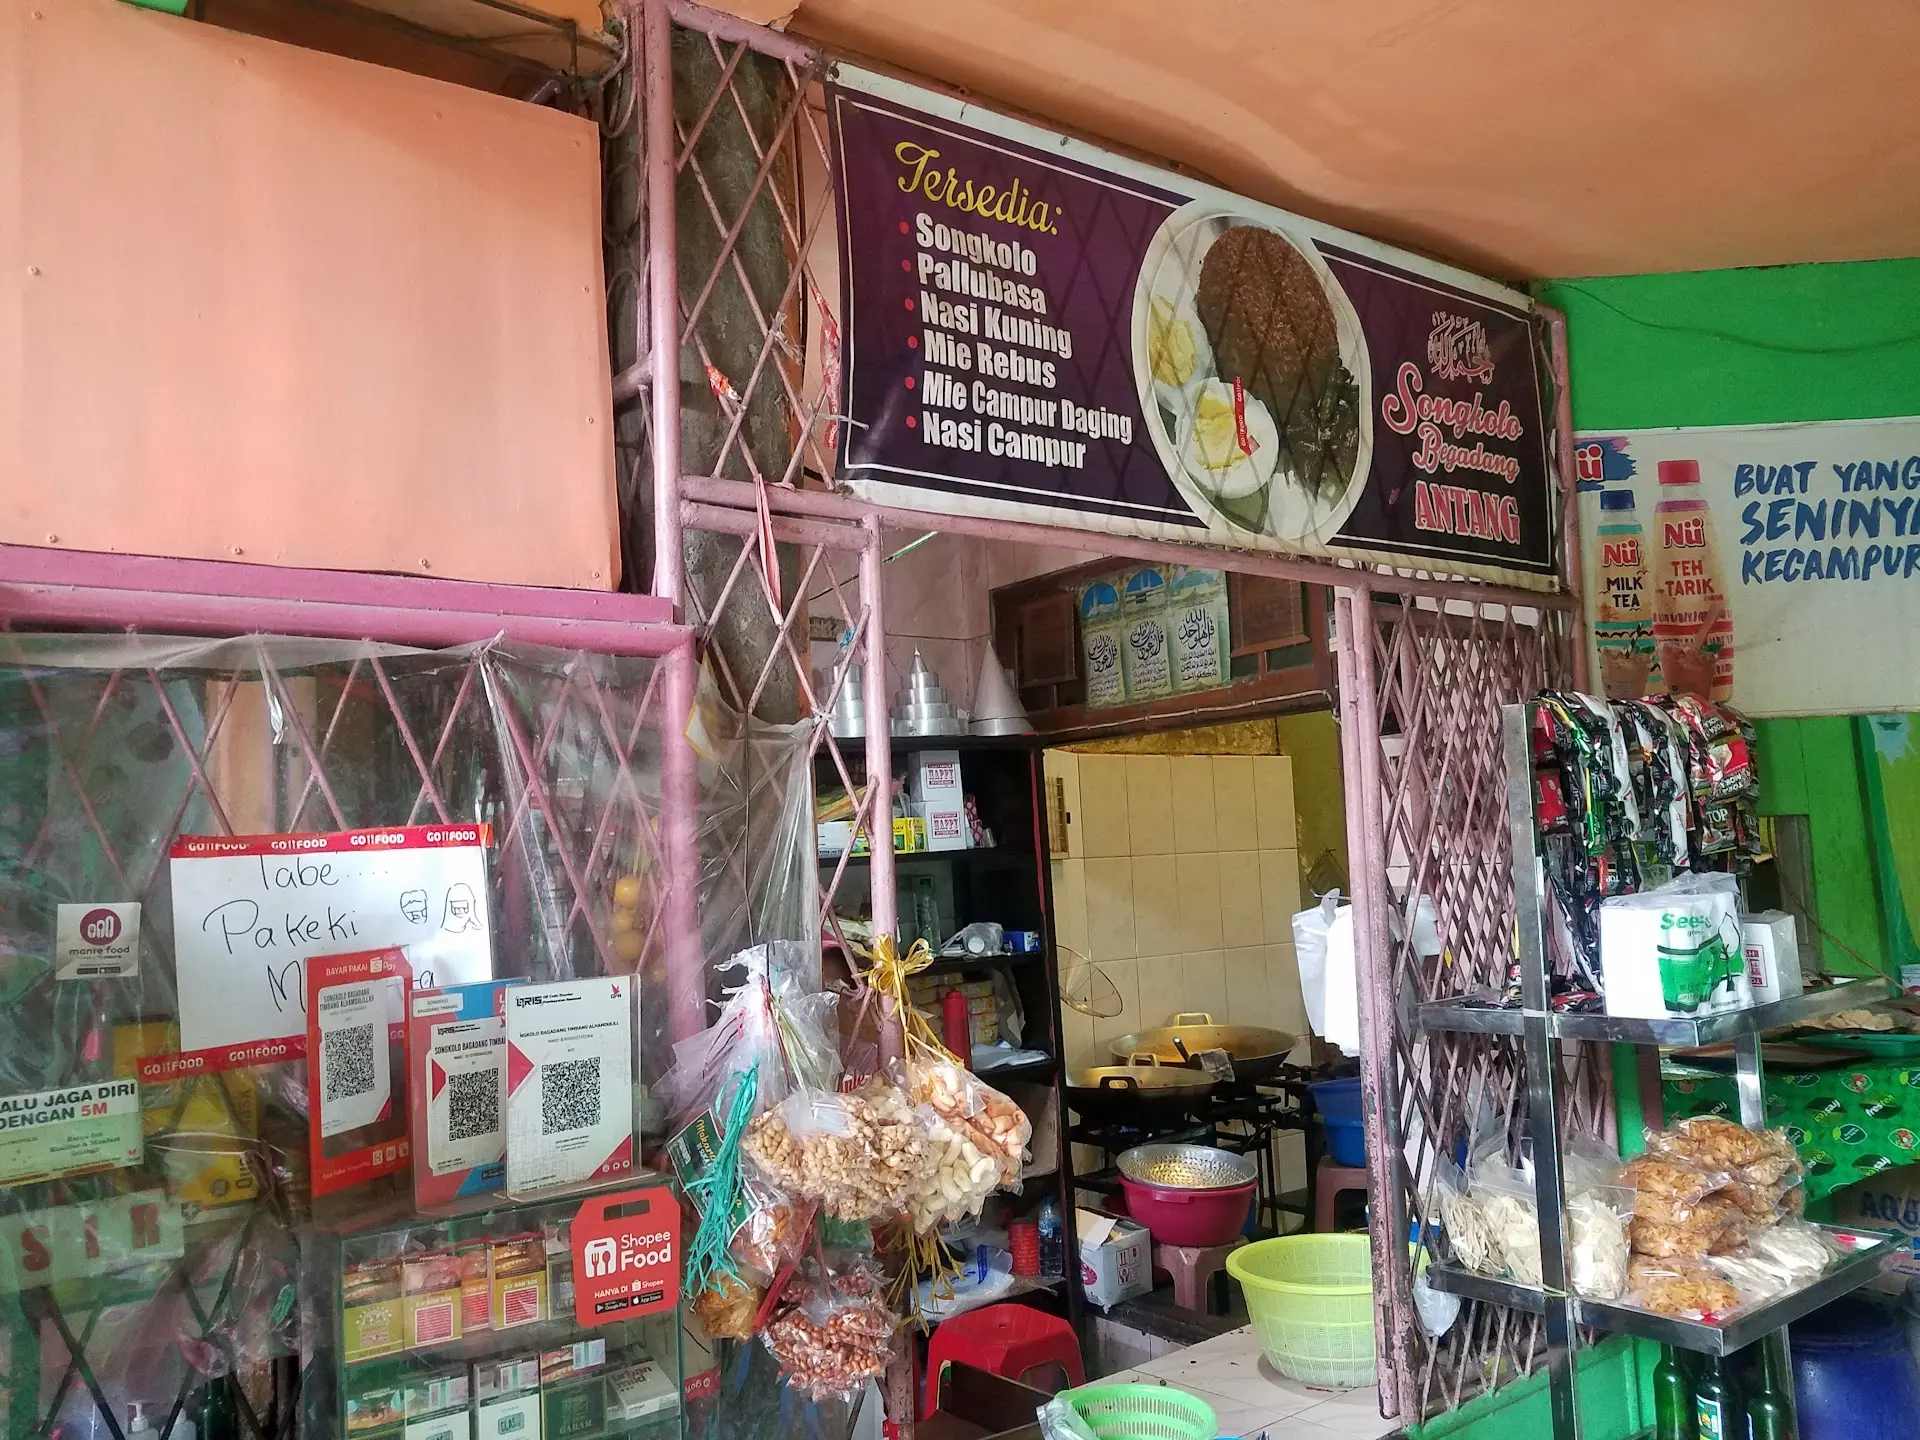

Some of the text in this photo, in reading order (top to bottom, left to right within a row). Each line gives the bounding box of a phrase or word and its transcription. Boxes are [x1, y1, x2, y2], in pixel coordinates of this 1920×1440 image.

[895, 141, 1063, 236] Tersedia:
[916, 213, 1037, 277] Songkolo
[917, 252, 1047, 314] Pallubasa
[920, 290, 1072, 359] Nasi Kuning
[923, 329, 1056, 389] Mie Rebus
[922, 370, 1133, 445] Mie Campur Daging
[1382, 362, 1523, 441] Songkolo
[922, 411, 1087, 469] Nasi Campur
[1413, 422, 1519, 484] Begadang
[1734, 455, 1920, 499] BUAT YANG
[1416, 480, 1520, 545] ANTANG
[1663, 516, 1706, 549] Nü
[1603, 538, 1640, 567] Nü
[1671, 560, 1704, 577] TEH
[1606, 576, 1643, 593] MILK
[1664, 578, 1715, 597] TARIK
[1612, 593, 1640, 608] TEA
[1706, 807, 1729, 823] TOP
[202, 899, 358, 954] Pakeki
[106, 944, 130, 954] food
[326, 965, 348, 976] BAYAR
[515, 995, 542, 1009] QRIS
[435, 1043, 462, 1055] SONGKOLO
[462, 1039, 488, 1050] BAGADANG
[44, 1089, 93, 1107] JAGA
[98, 1083, 135, 1099] DIRI
[81, 1101, 108, 1117] 5M
[696, 1119, 718, 1161] Makaro
[620, 1231, 671, 1250] Shopee
[620, 1242, 672, 1271] Food
[594, 1279, 664, 1299] HANYA DI Shopee
